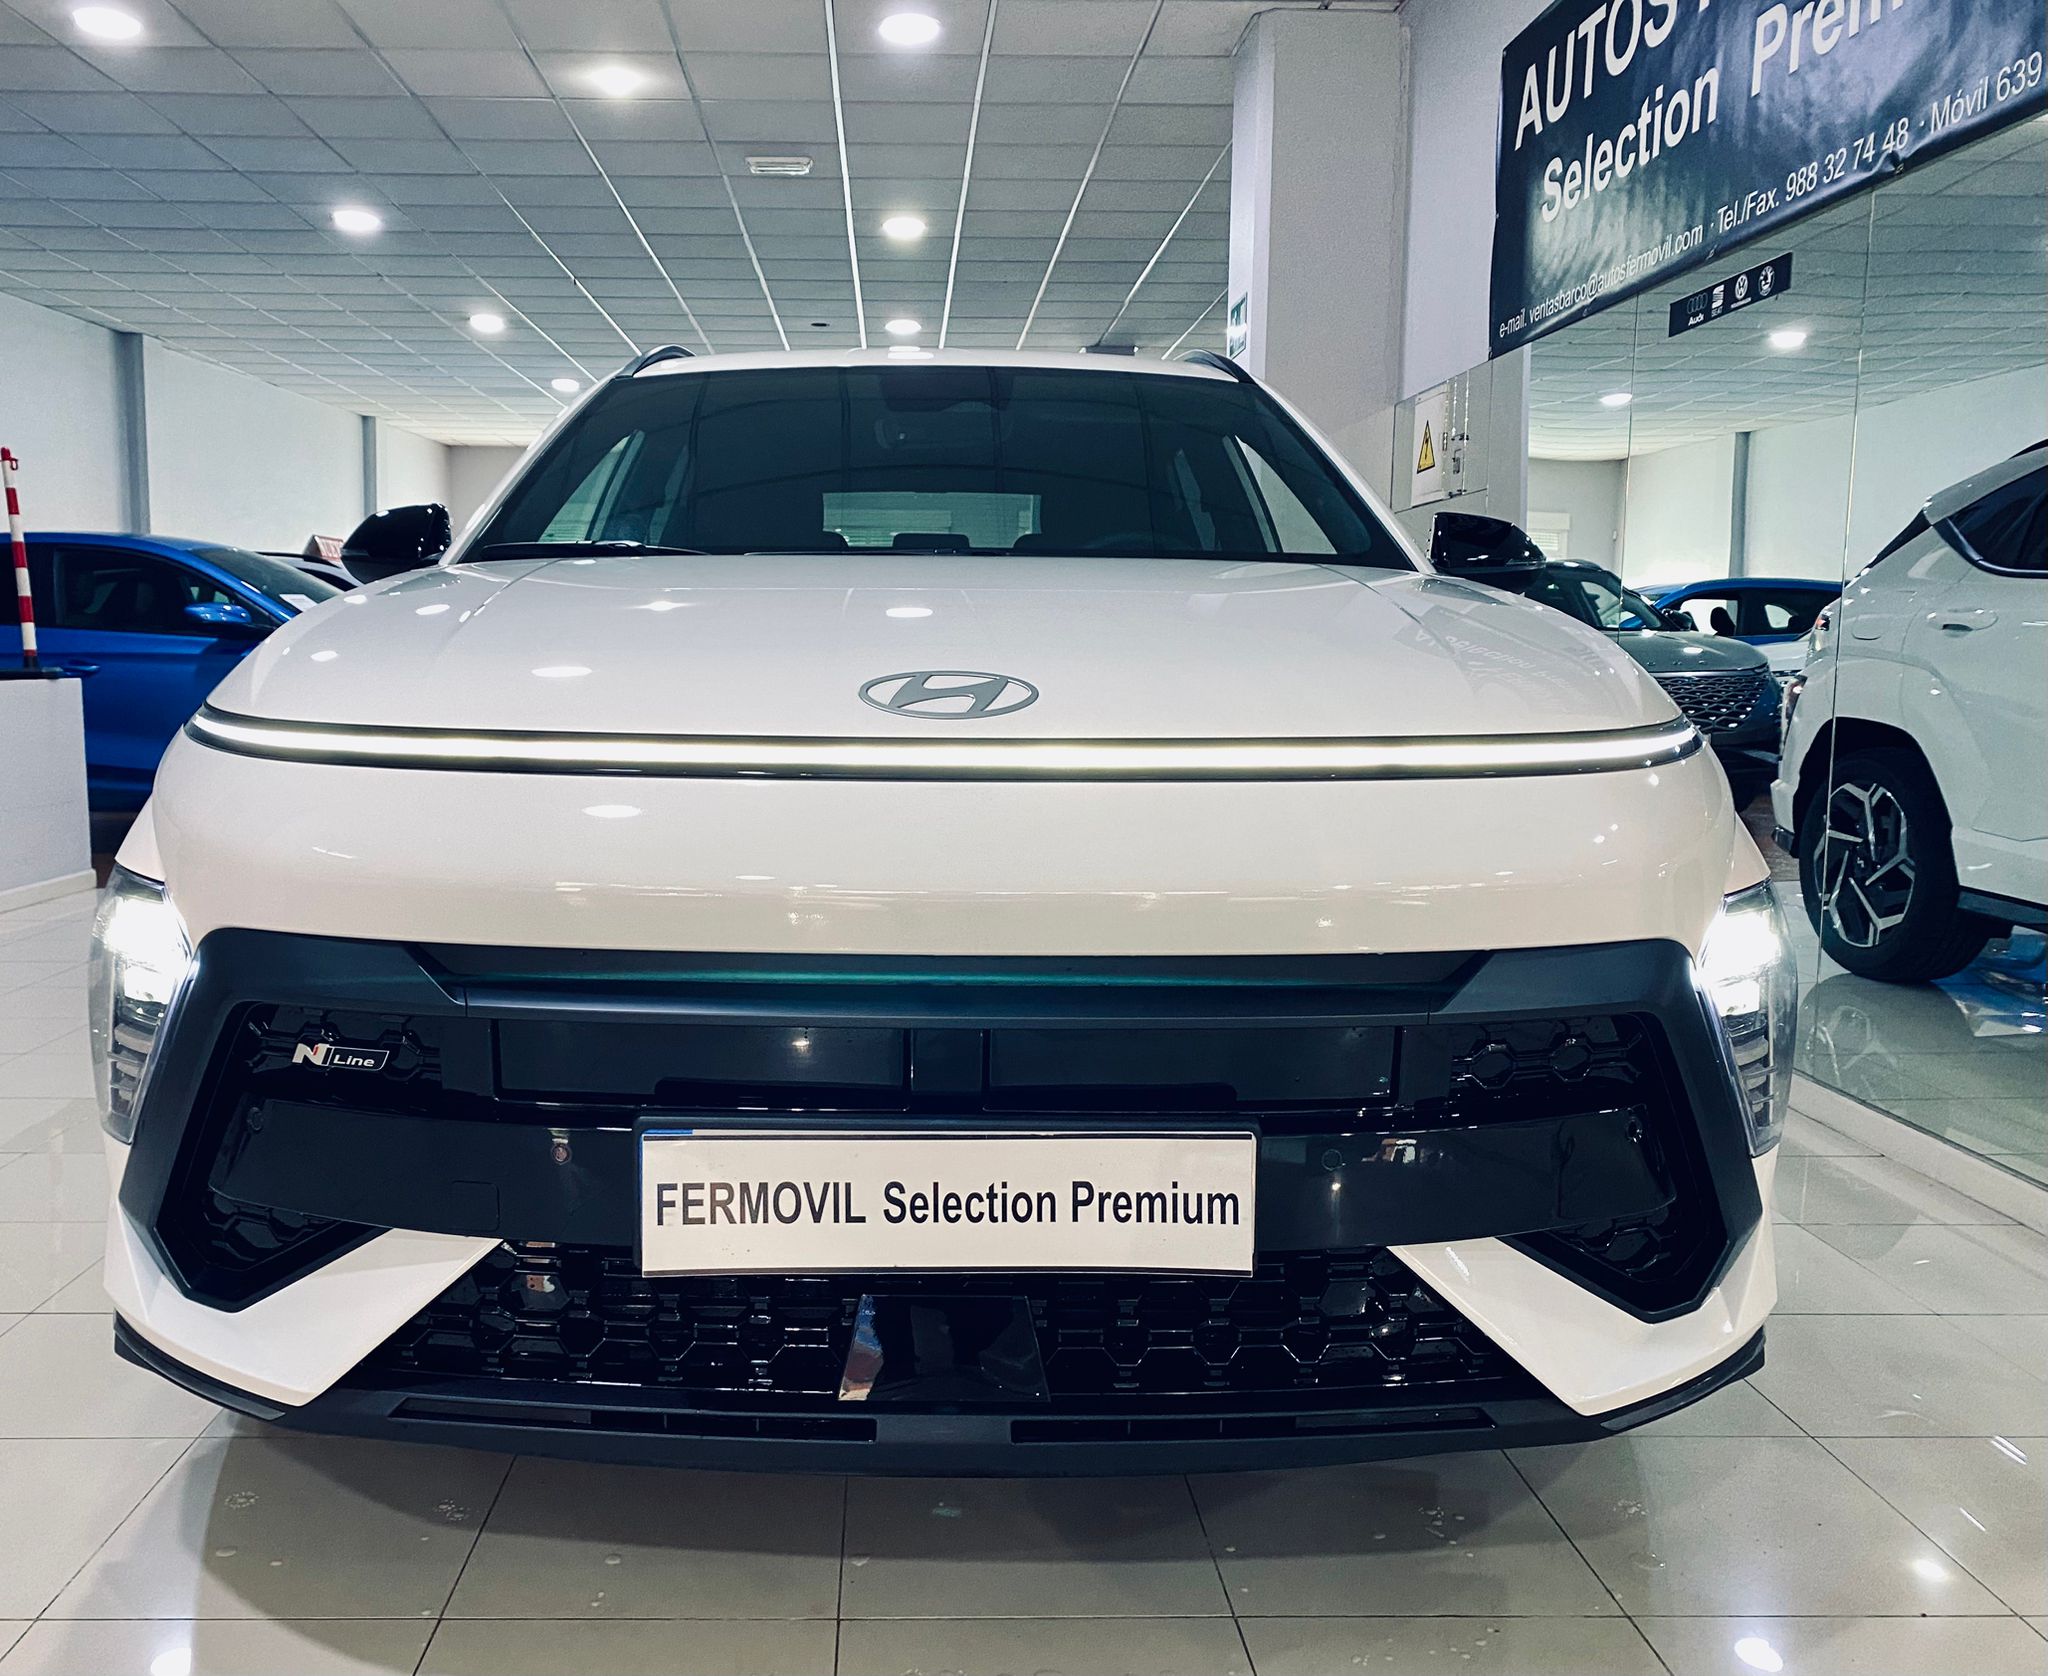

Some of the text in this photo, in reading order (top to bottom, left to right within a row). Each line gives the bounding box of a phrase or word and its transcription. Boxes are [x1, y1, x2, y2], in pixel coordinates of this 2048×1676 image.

[1541, 66, 1719, 223] Selection
[1529, 224, 1703, 324] ventasbarco@autosfermovil.com
[1786, 161, 1818, 201] 988
[1823, 147, 1848, 184] 32
[1853, 132, 1876, 170] 74
[1882, 117, 1909, 154] 48
[1930, 76, 1989, 134] Móvil
[1995, 51, 2043, 102] 639
[1688, 312, 1704, 326] Audi
[333, 1054, 375, 1067] Line
[656, 1180, 1240, 1227] FERMOVIL Selection Premium
